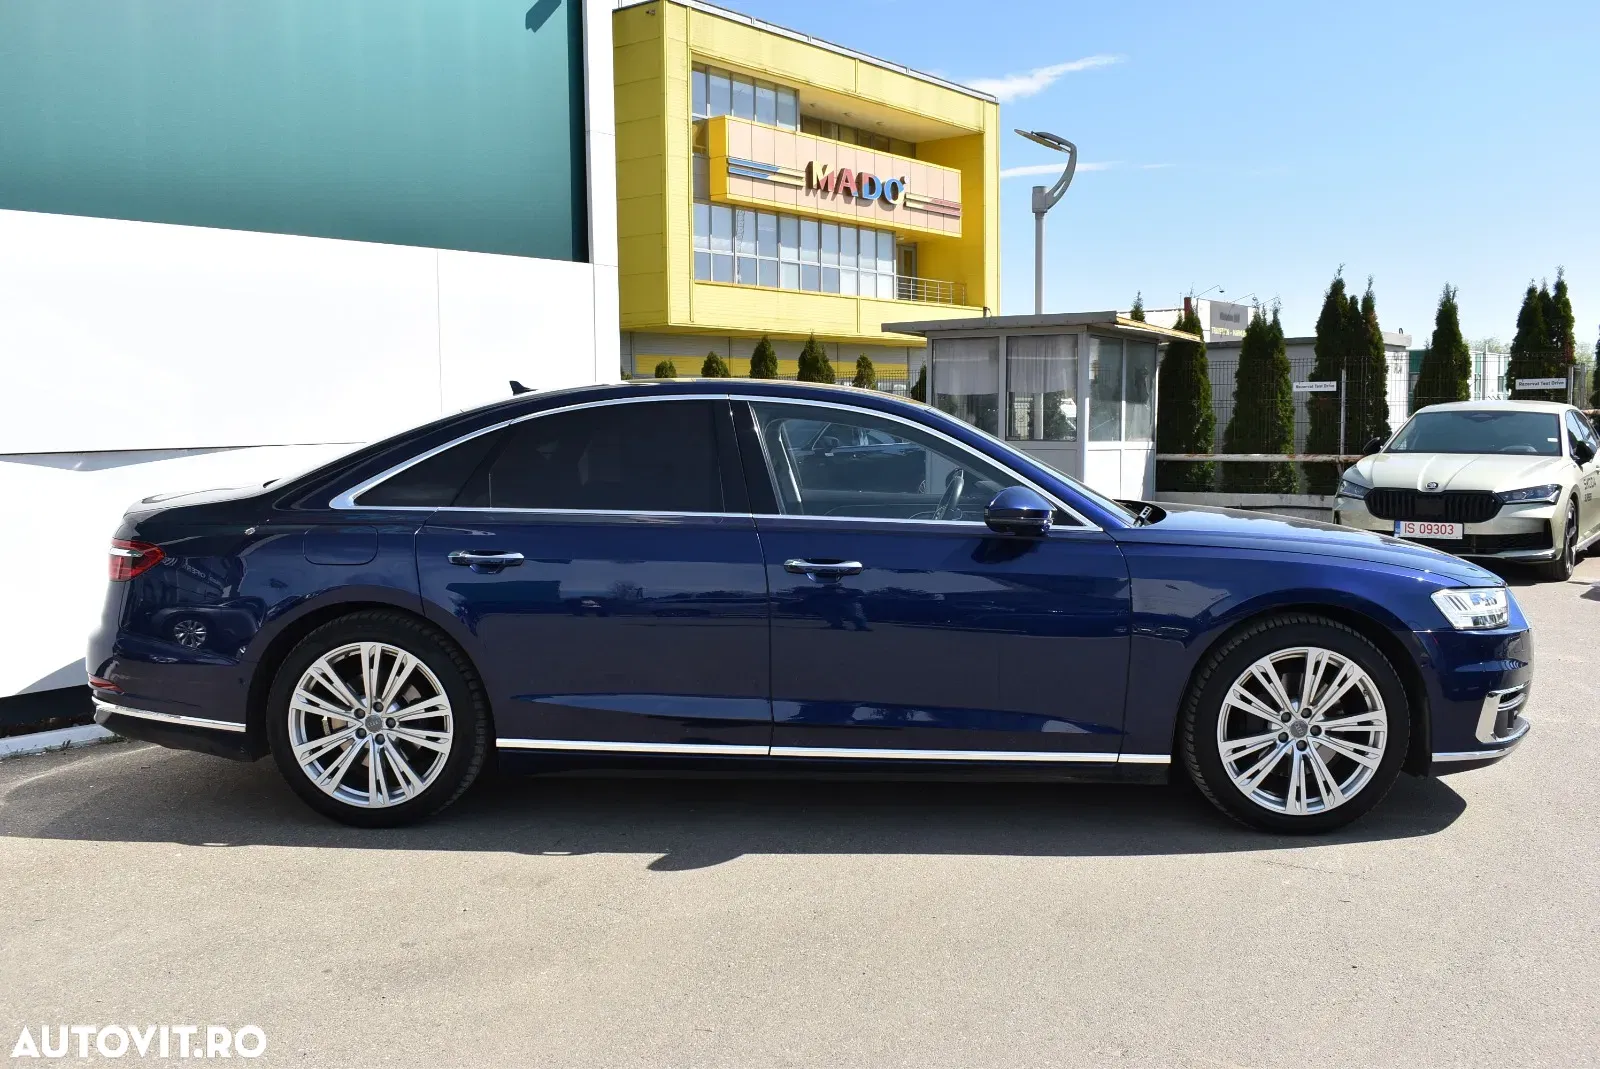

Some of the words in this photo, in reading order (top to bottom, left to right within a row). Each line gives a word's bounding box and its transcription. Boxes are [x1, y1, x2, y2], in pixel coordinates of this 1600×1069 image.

[806, 160, 905, 205] MADO
[1404, 522, 1416, 534] IS
[1419, 523, 1455, 535] 09303
